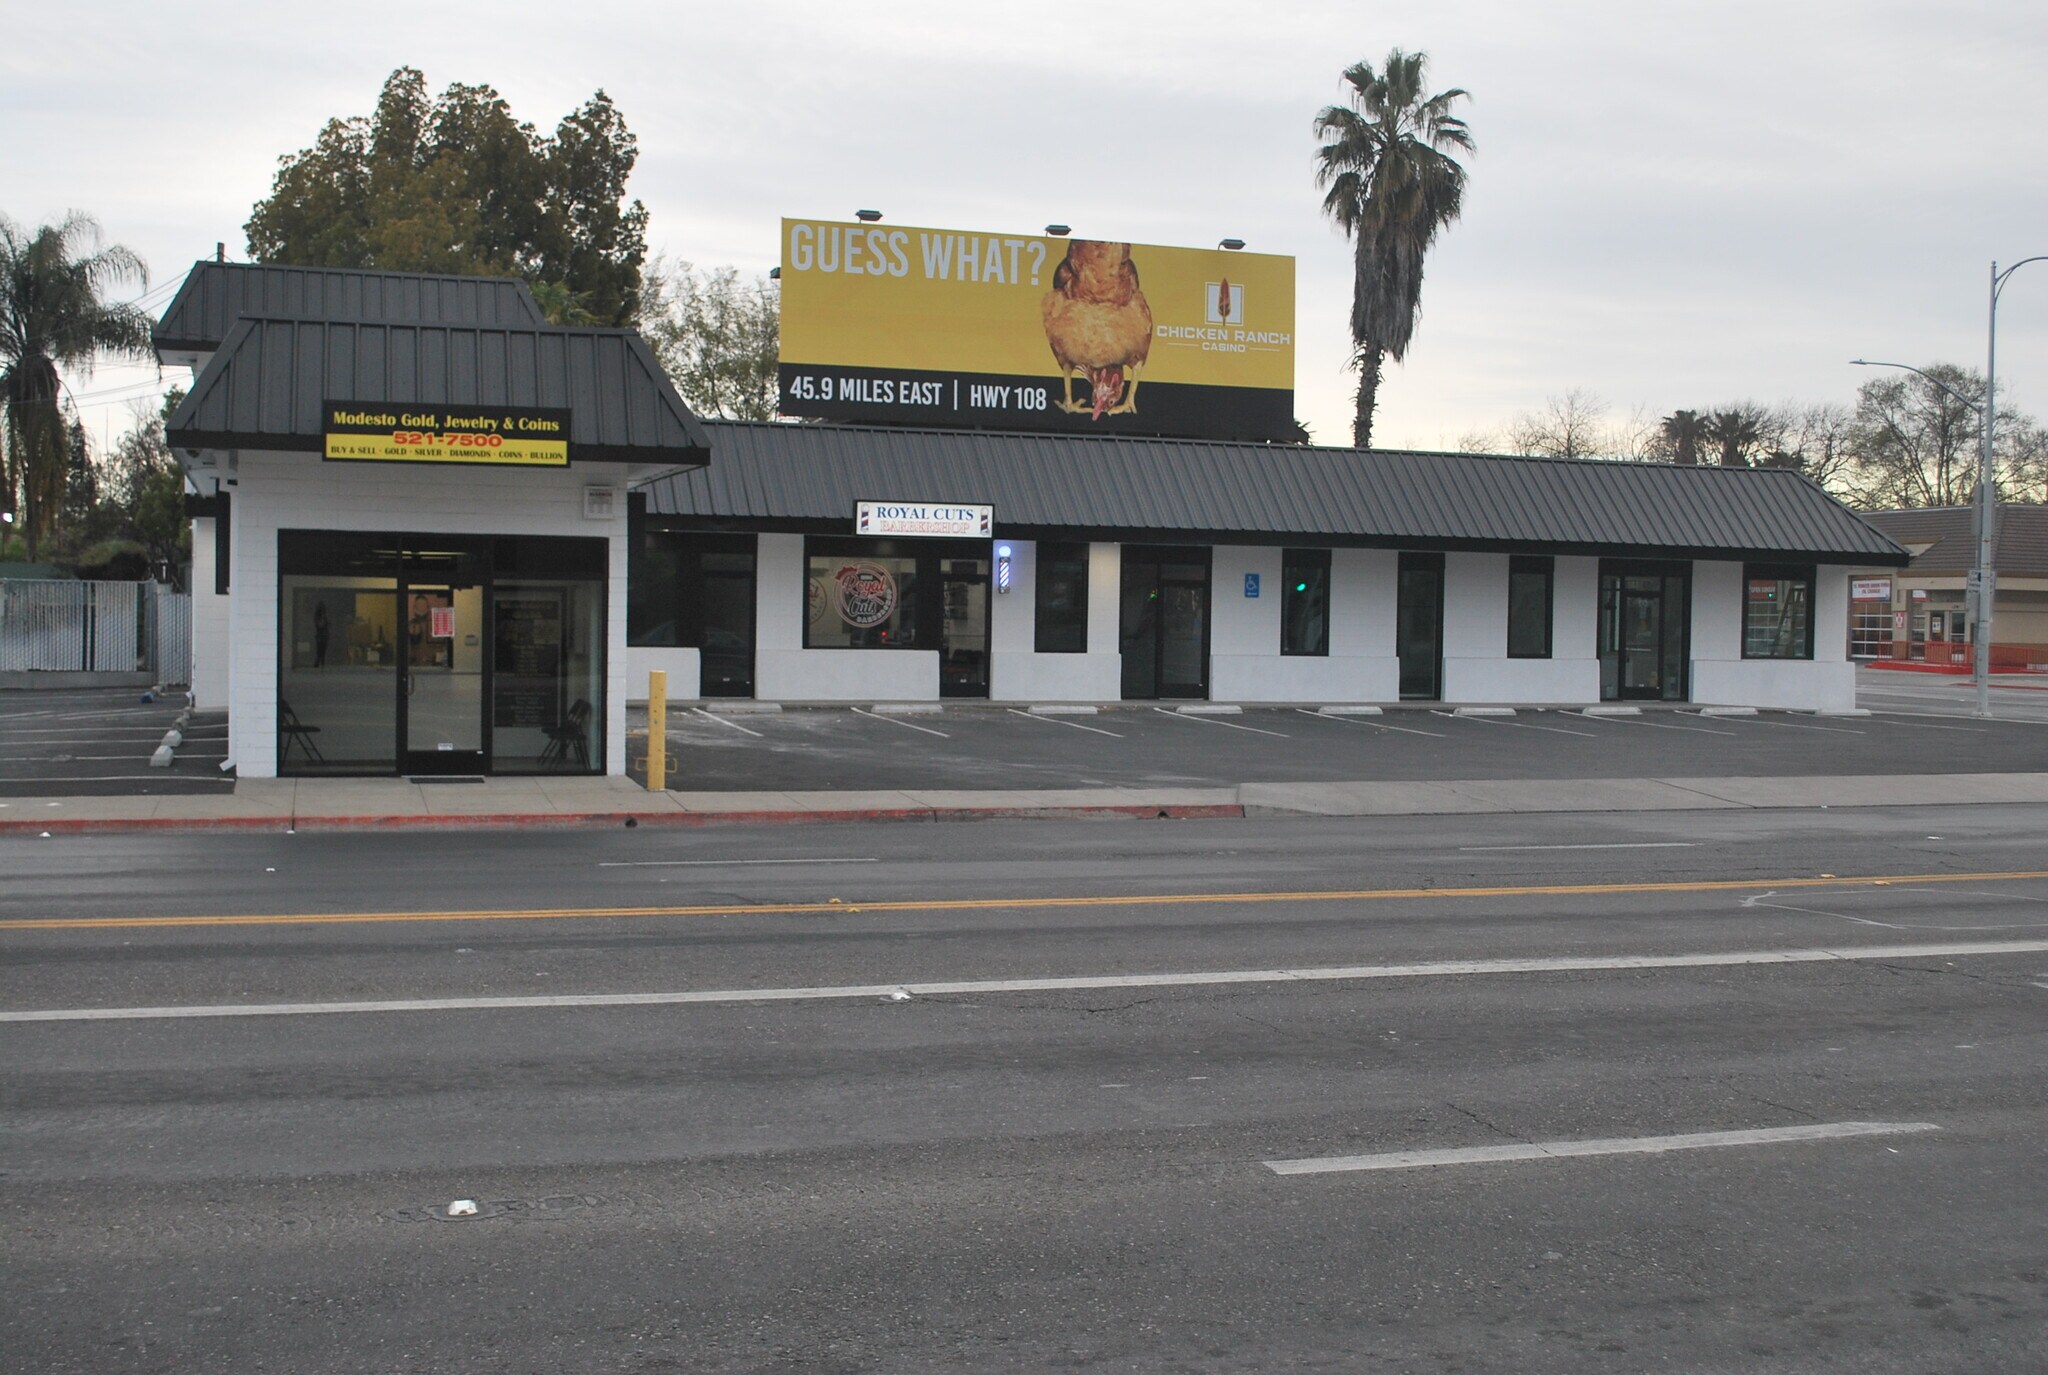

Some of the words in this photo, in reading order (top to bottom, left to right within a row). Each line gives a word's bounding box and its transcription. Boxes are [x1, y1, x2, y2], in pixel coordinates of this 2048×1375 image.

[790, 223, 910, 278] GUESS
[920, 232, 1047, 286] WHAT?
[1156, 325, 1228, 341] CHICKEN
[1234, 330, 1291, 345] RANCH
[1202, 341, 1246, 353] CASINO
[789, 376, 834, 401] 45.9
[839, 378, 894, 403] MILES
[900, 380, 943, 406] EAST
[970, 384, 1011, 409] HWY
[1014, 386, 1048, 411] 108
[333, 411, 396, 426] Modesto
[401, 413, 440, 429] Gold,
[444, 415, 499, 432] Jewelry
[503, 417, 515, 430] &
[518, 417, 560, 431] Coins
[393, 431, 503, 447] 521-7500
[331, 446, 346, 455] BUY
[358, 446, 376, 455] SELL
[385, 447, 407, 456] GOLD
[415, 448, 442, 457] SILVER
[449, 449, 491, 458] DIAMONDS
[498, 450, 523, 459] COINS
[530, 451, 564, 461] BULLION
[877, 506, 930, 520] ROYAL
[934, 507, 974, 521] CUTS
[880, 519, 971, 534] BARBERSHOP
[842, 574, 886, 598] Royal
[849, 596, 877, 618] Cuts
